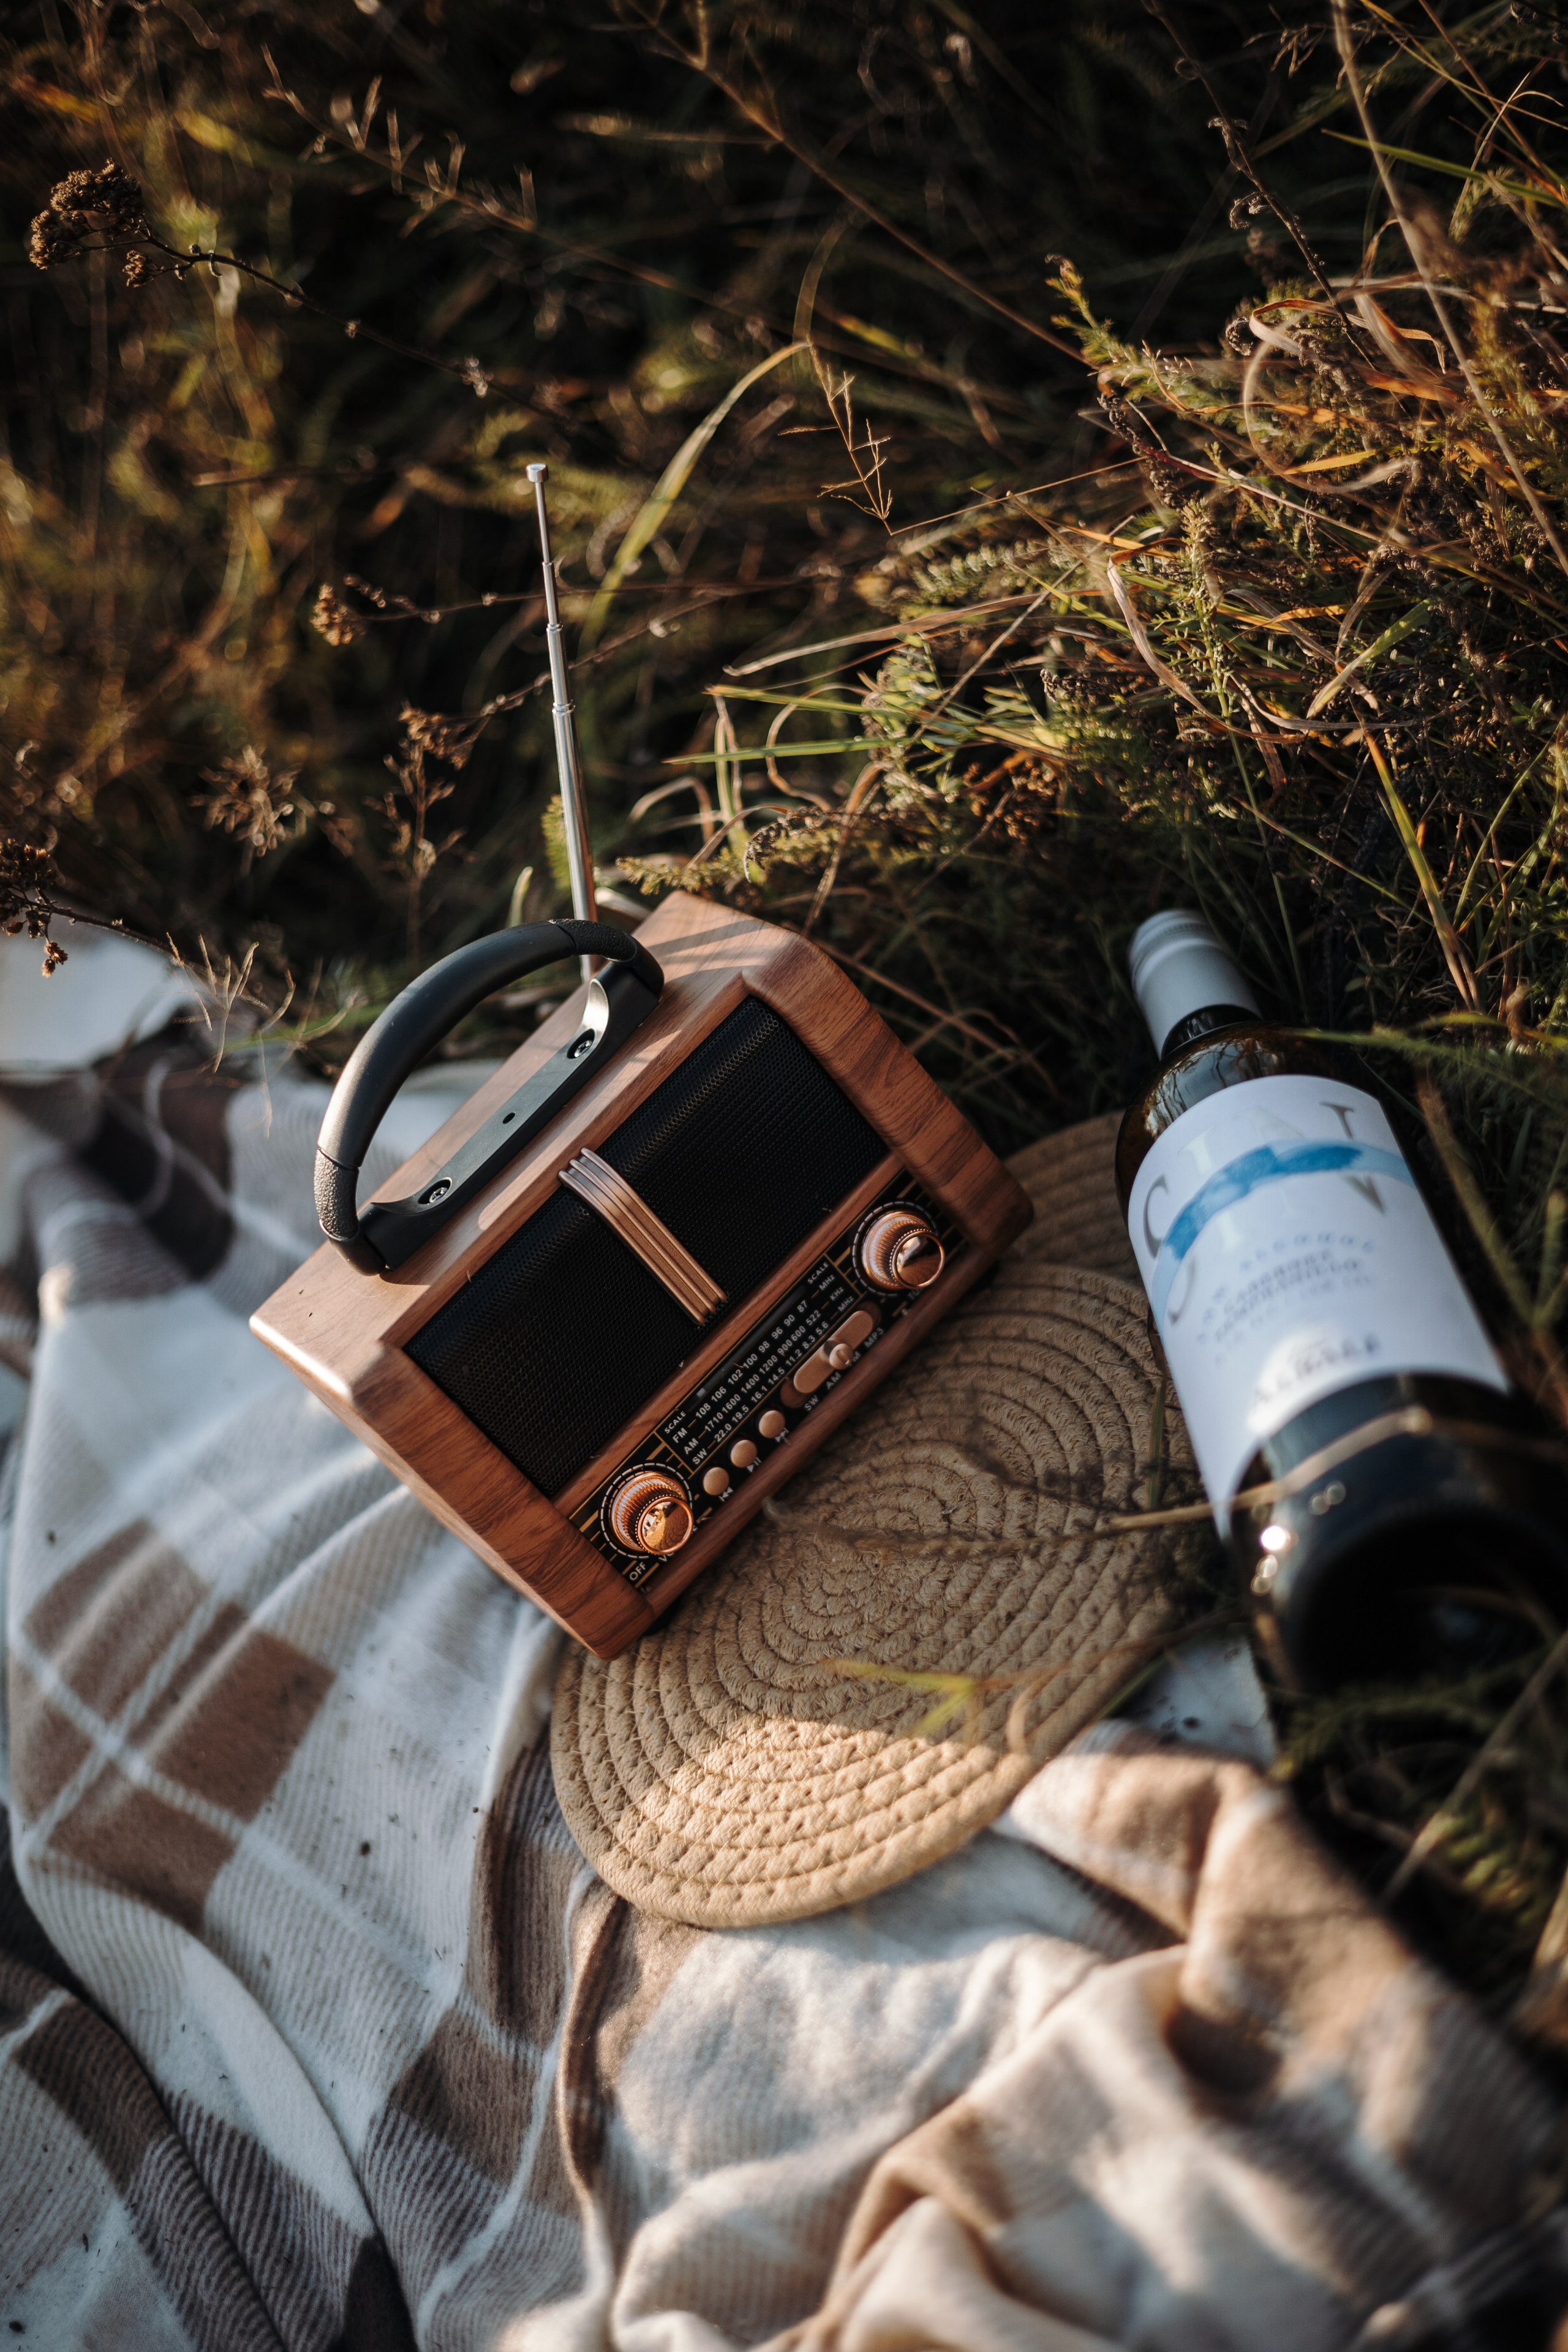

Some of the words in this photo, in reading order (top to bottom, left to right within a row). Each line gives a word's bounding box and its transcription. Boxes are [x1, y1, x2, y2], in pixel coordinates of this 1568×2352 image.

[807, 1262, 828, 1284] SCALE
[672, 1427, 687, 1442] FM
[696, 1403, 710, 1418] 108
[711, 1386, 726, 1401] 106
[728, 1369, 743, 1384] 102
[743, 1353, 757, 1368] 100
[758, 1341, 769, 1352] 98
[771, 1327, 782, 1338] 96
[783, 1314, 794, 1325] 90
[797, 1300, 807, 1312] 87
[819, 1275, 834, 1290] MHz
[684, 1438, 698, 1454] AM
[704, 1412, 723, 1431] 1710
[722, 1393, 740, 1412] 1600
[741, 1374, 759, 1393] 1400
[759, 1355, 777, 1373] 1200
[777, 1340, 792, 1355] 900
[791, 1325, 805, 1341] 600
[805, 1310, 820, 1325] 522
[830, 1287, 843, 1300] KHz
[692, 1448, 707, 1464] SW
[714, 1423, 731, 1442] 22.0
[732, 1404, 748, 1422] 19.5
[751, 1385, 767, 1402] 16.1
[767, 1366, 784, 1384] 14.5
[785, 1349, 802, 1365] 11.2
[802, 1335, 815, 1349] 8.3
[815, 1321, 828, 1335] 5.6
[837, 1296, 853, 1311] MHz
[804, 1395, 818, 1410] SW
[826, 1372, 840, 1389] AM
[864, 1327, 883, 1347] MP3
[664, 1411, 685, 1433] SCALE
[629, 1562, 645, 1580] OFF
